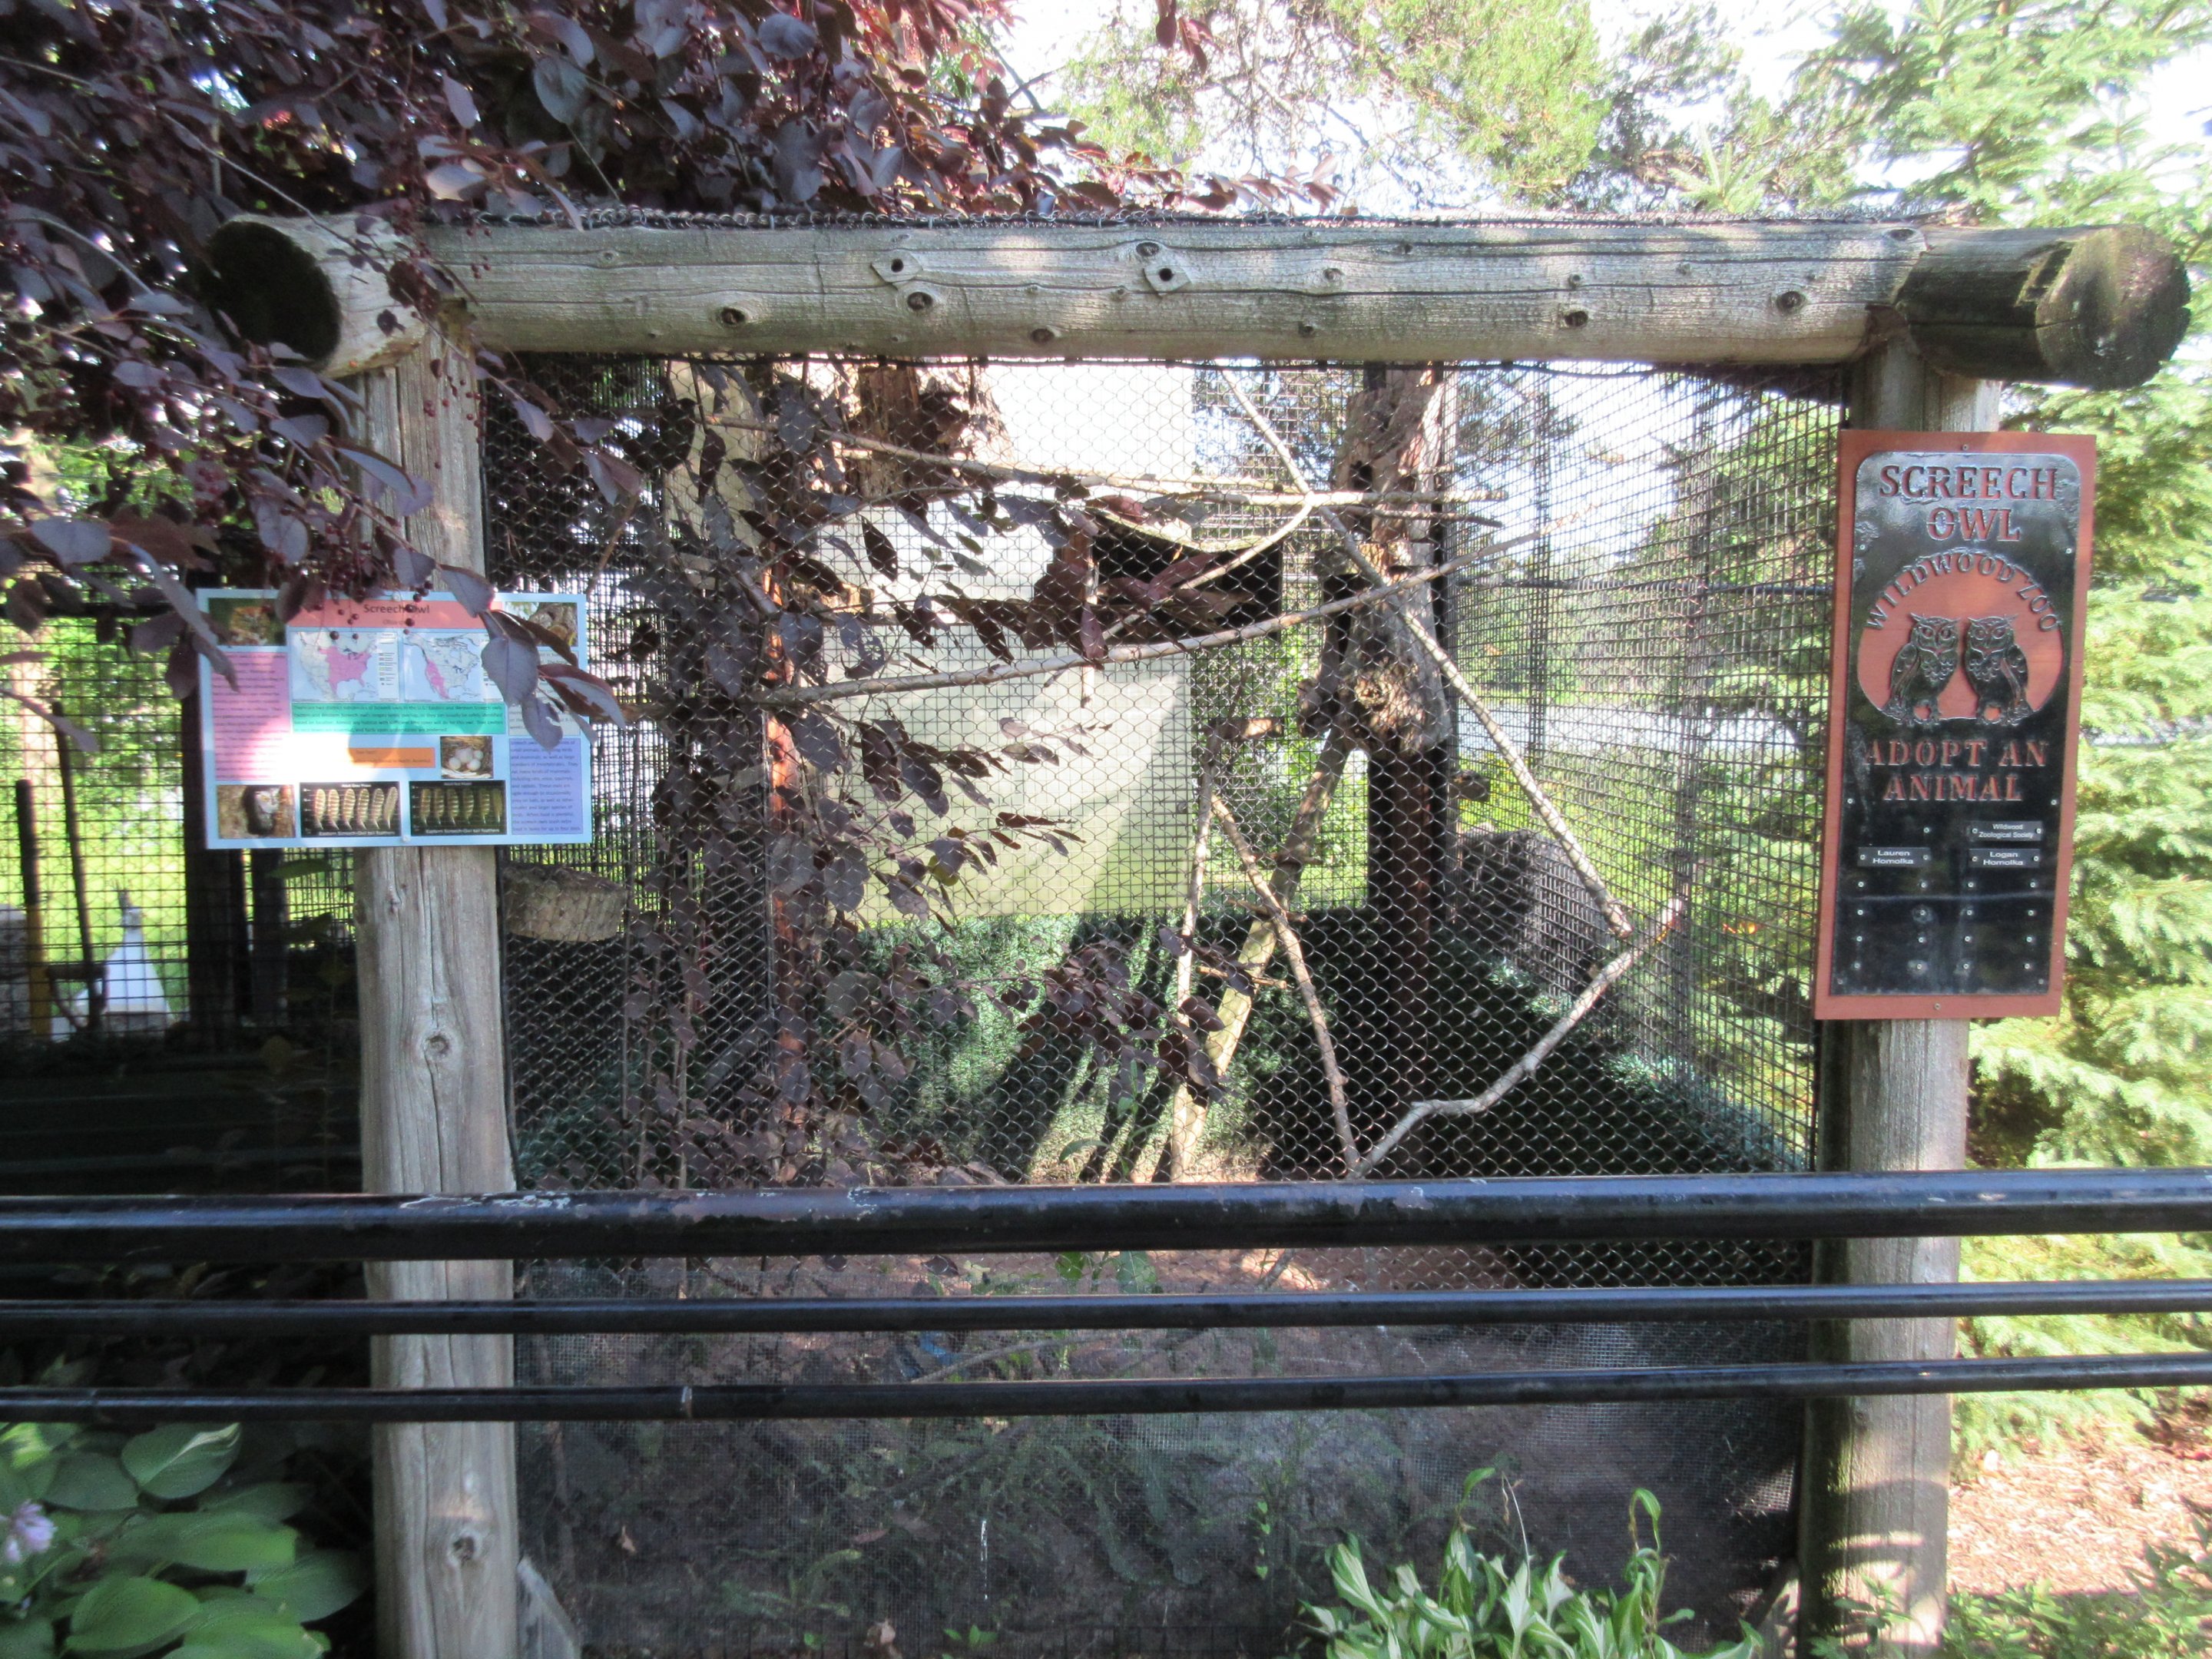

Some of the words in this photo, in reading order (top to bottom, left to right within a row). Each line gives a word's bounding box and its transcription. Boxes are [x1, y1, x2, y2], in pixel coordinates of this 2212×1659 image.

[1879, 465, 2058, 501] SCREECH
[1926, 506, 2021, 541] OWL
[1866, 553, 2015, 629] WILDWOOD
[2017, 579, 2061, 631] ZOO
[363, 604, 405, 614] Screech
[1864, 738, 1988, 767] ADOPT
[1998, 740, 2050, 767] AN
[1883, 773, 2023, 801] ANIMAL
[1979, 831, 2012, 839] Zoological
